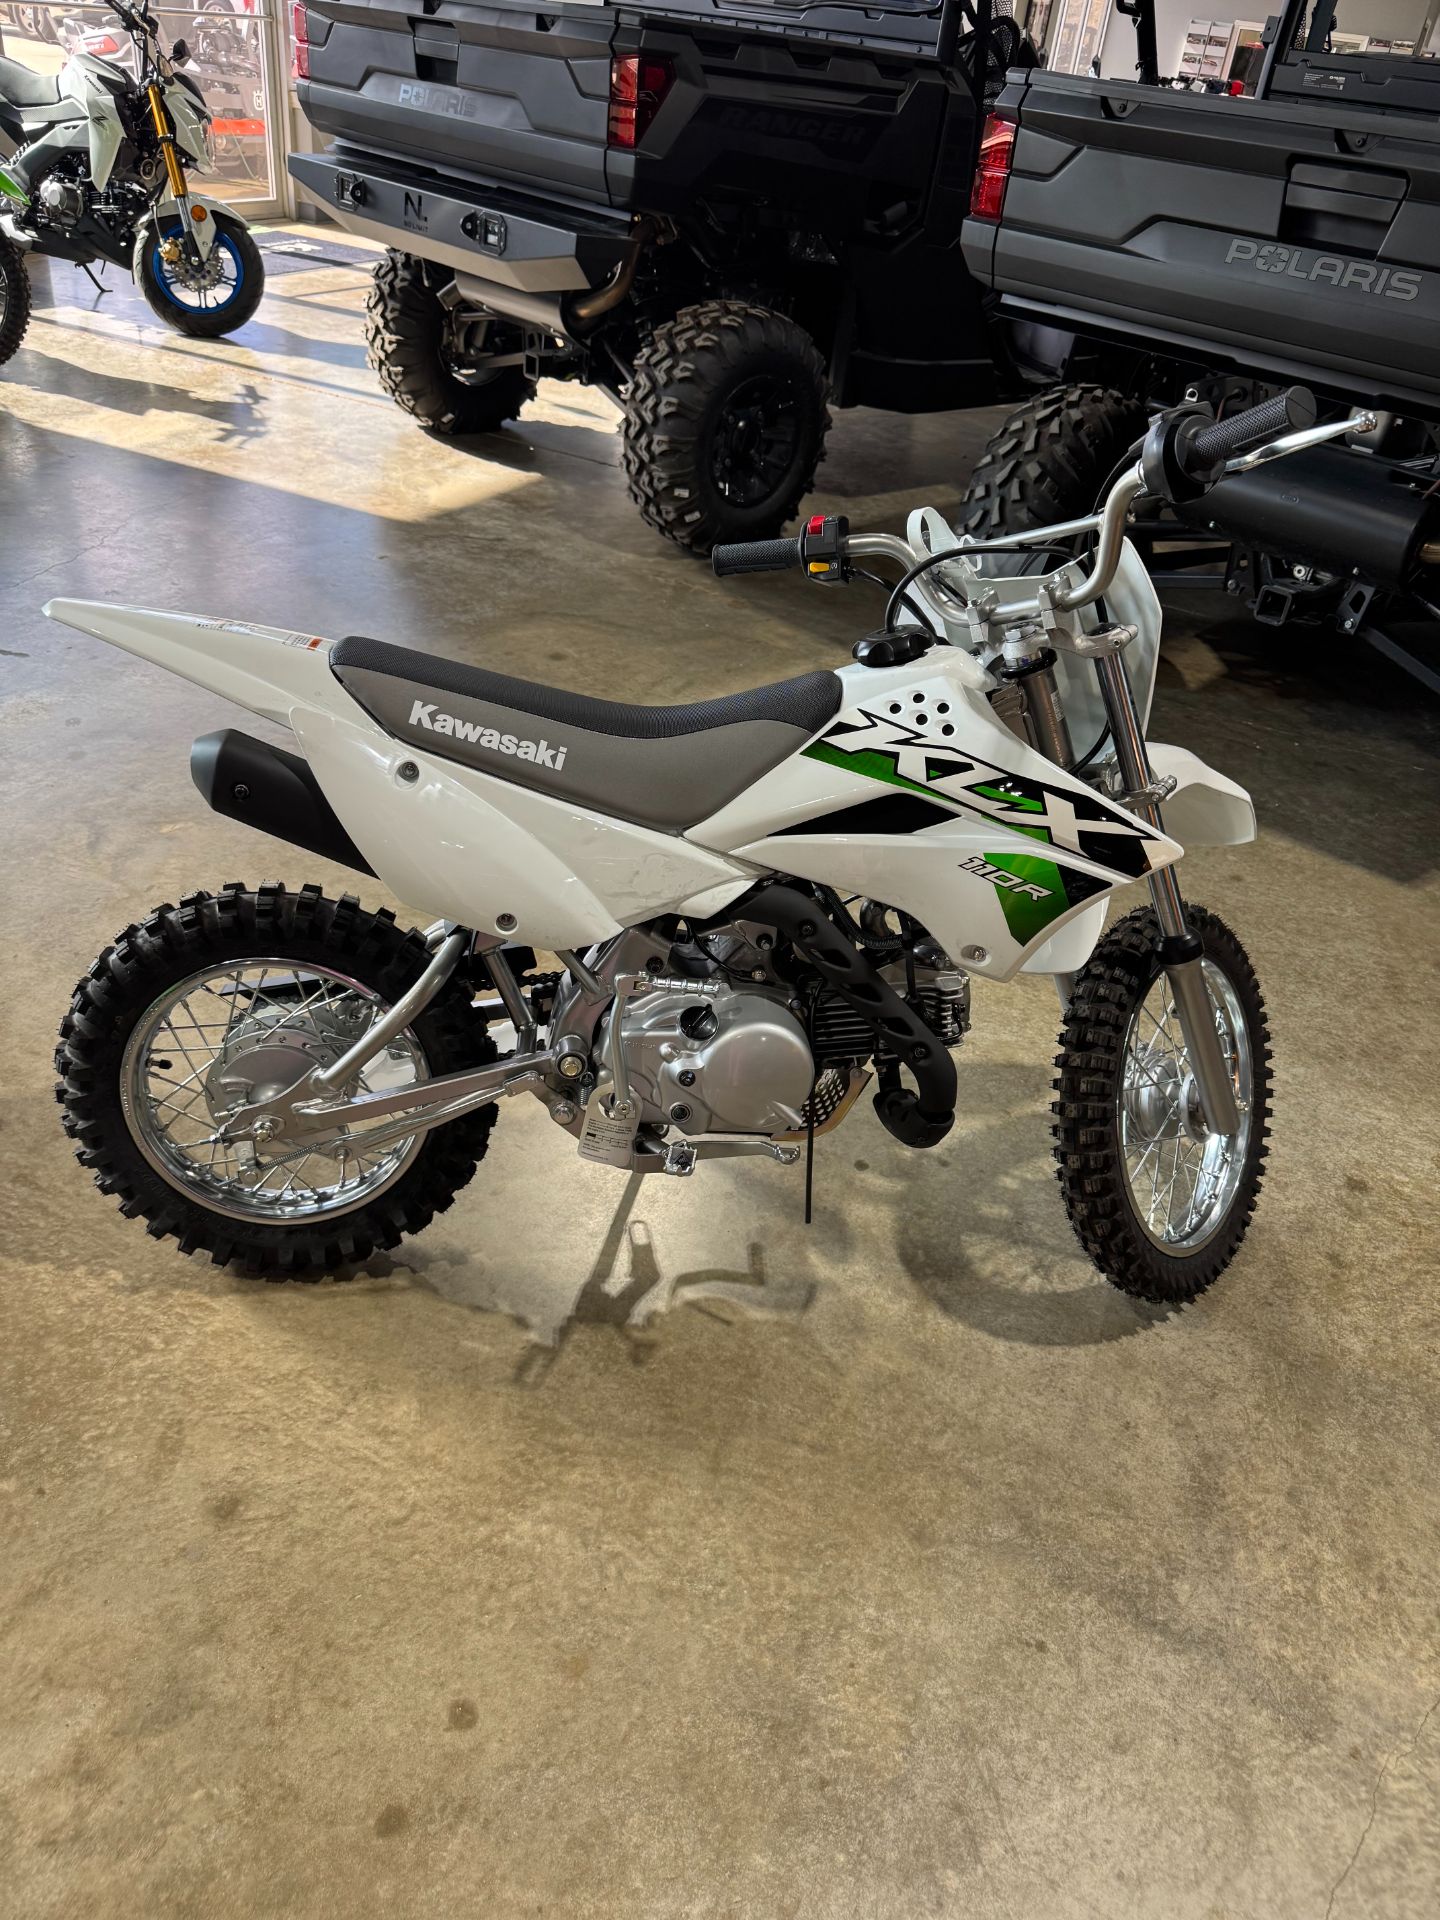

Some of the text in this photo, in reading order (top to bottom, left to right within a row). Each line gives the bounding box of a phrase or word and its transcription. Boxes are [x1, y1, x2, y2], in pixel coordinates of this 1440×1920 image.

[399, 83, 479, 117] POLARIS
[720, 106, 867, 144] RANGER
[1224, 238, 1424, 301] POLARIS
[408, 699, 568, 771] Kawasaki
[819, 707, 1163, 860] KLX
[957, 856, 1055, 902] 110R
